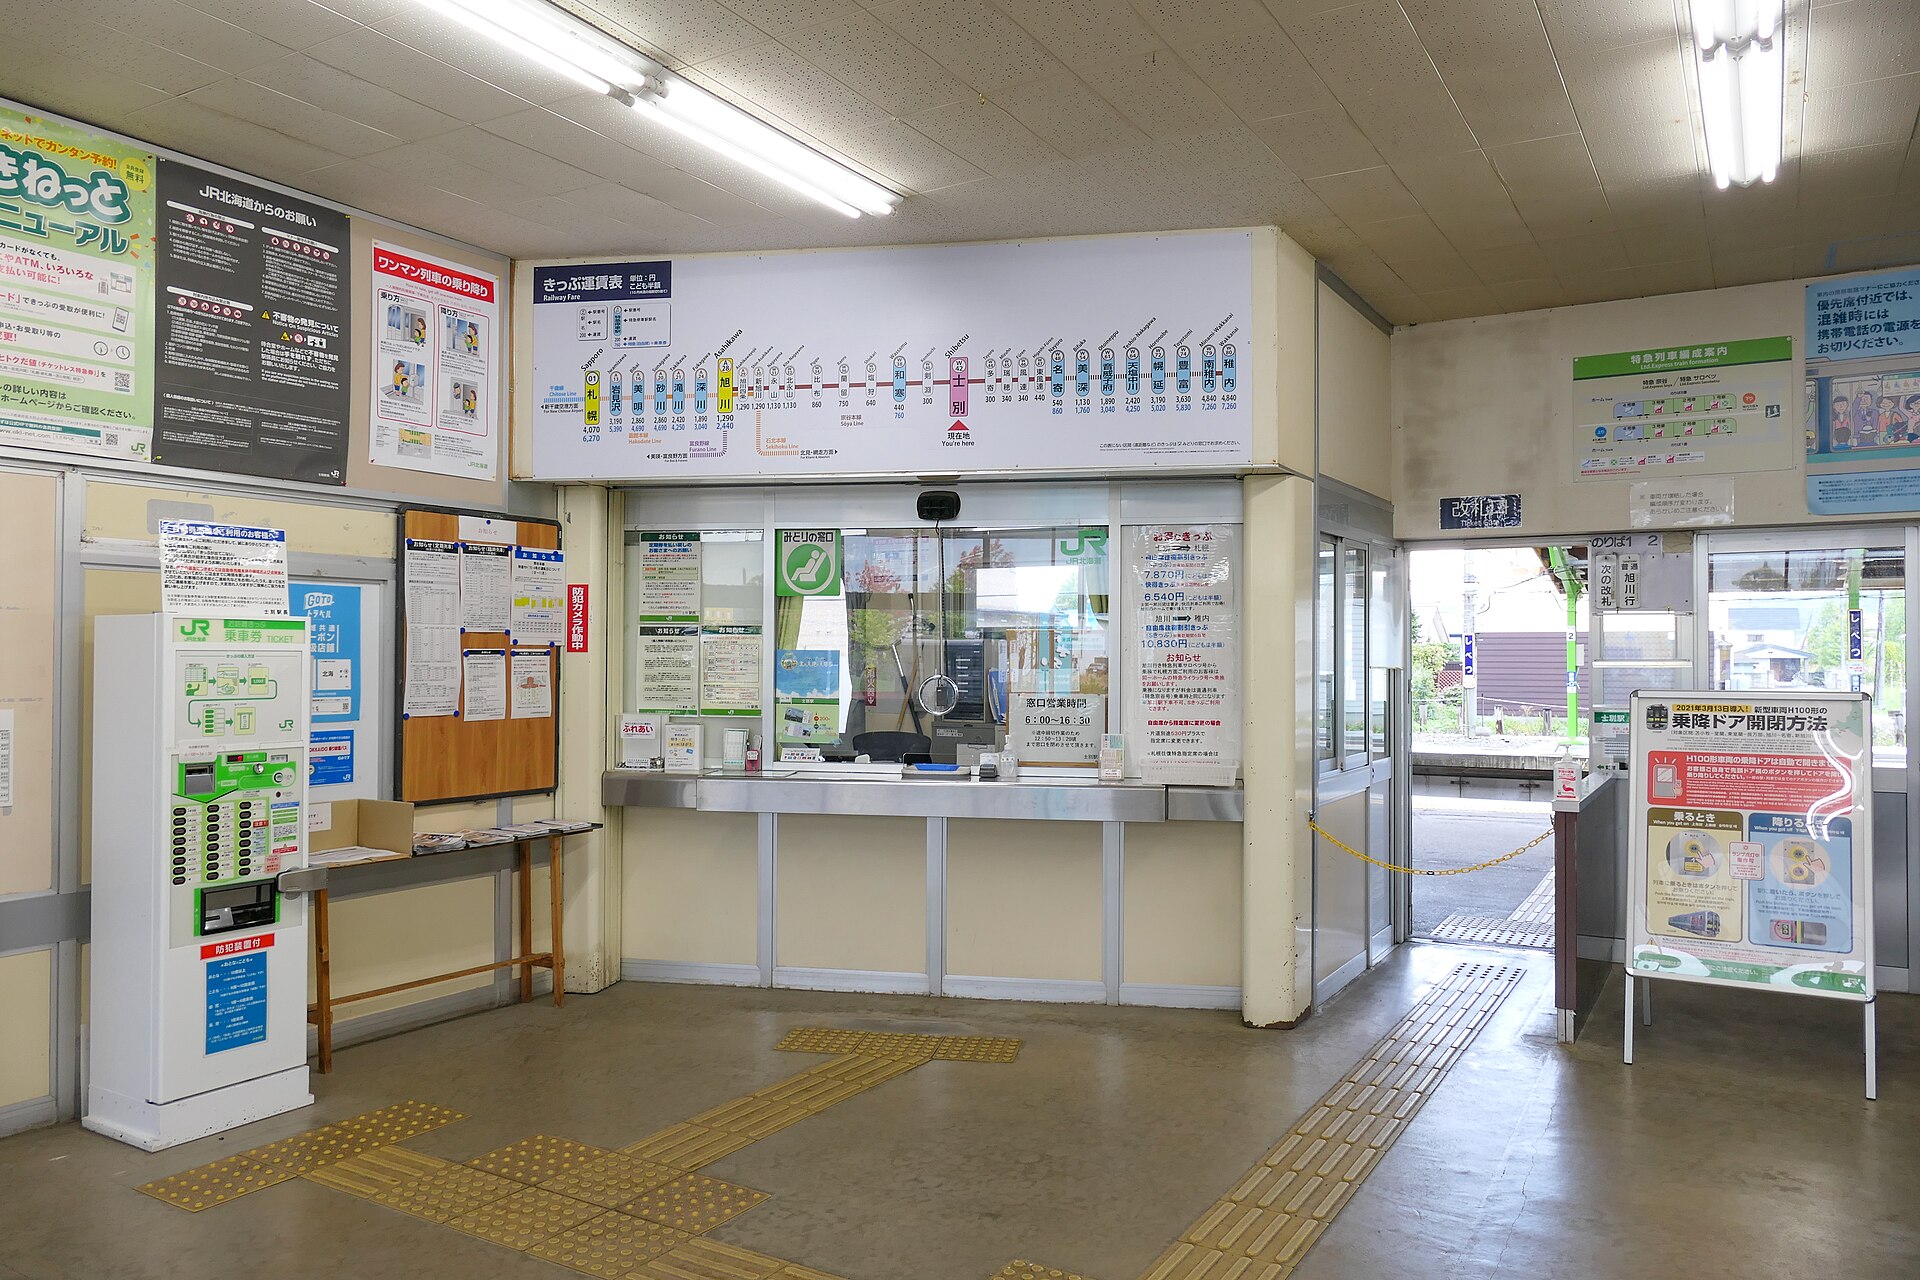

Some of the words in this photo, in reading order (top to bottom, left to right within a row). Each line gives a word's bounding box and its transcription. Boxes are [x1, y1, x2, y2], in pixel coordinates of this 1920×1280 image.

[544, 274, 622, 292] きっぷ運賃表
[380, 291, 400, 303] 乗り方
[544, 294, 566, 302] Railway
[1817, 290, 1913, 312] 優先席付近では、
[440, 306, 458, 318] 降り方
[1818, 308, 1889, 326] 混雑時には
[1818, 319, 1920, 340] 携帯電話の電源を
[714, 329, 743, 359] Asahikawa
[945, 334, 970, 359] Shibetsu
[1818, 337, 1904, 354] お切りください。
[580, 348, 604, 372] Sapporo
[1630, 346, 1728, 364] 特急列車編成案内
[1053, 364, 1063, 392] 名寄
[1224, 359, 1234, 387] 稚内
[656, 384, 665, 410] 砂川
[674, 383, 683, 410] 滝川
[697, 383, 706, 409] 深川
[720, 378, 730, 409] 旭川
[953, 375, 965, 414] 士別
[587, 388, 597, 422] 札幌
[131, 443, 146, 453] JR
[784, 532, 834, 543] みどりの窓口
[1060, 530, 1107, 556] JR
[1648, 535, 1658, 546] 2
[522, 552, 555, 560] お知らせ
[1601, 565, 1612, 606] 次の改札
[1624, 573, 1635, 606] 旭川行
[572, 587, 584, 650] 防犯カメラ作動中
[180, 620, 210, 636] JR
[224, 630, 262, 643] 乗車券
[266, 635, 294, 643] TICKET
[1851, 614, 1860, 656] しべつ
[1166, 654, 1201, 662] お知らせ
[1465, 636, 1473, 674] しべつ
[1026, 698, 1087, 708] 窓口営業時間
[279, 720, 293, 729] JR
[1601, 714, 1624, 722] 士別駅
[1672, 713, 1828, 731] 乗降ドア開閉方法
[623, 724, 653, 733] ふれあい
[1674, 811, 1715, 822] 乗るとき
[216, 938, 260, 954] 防犯装置付
